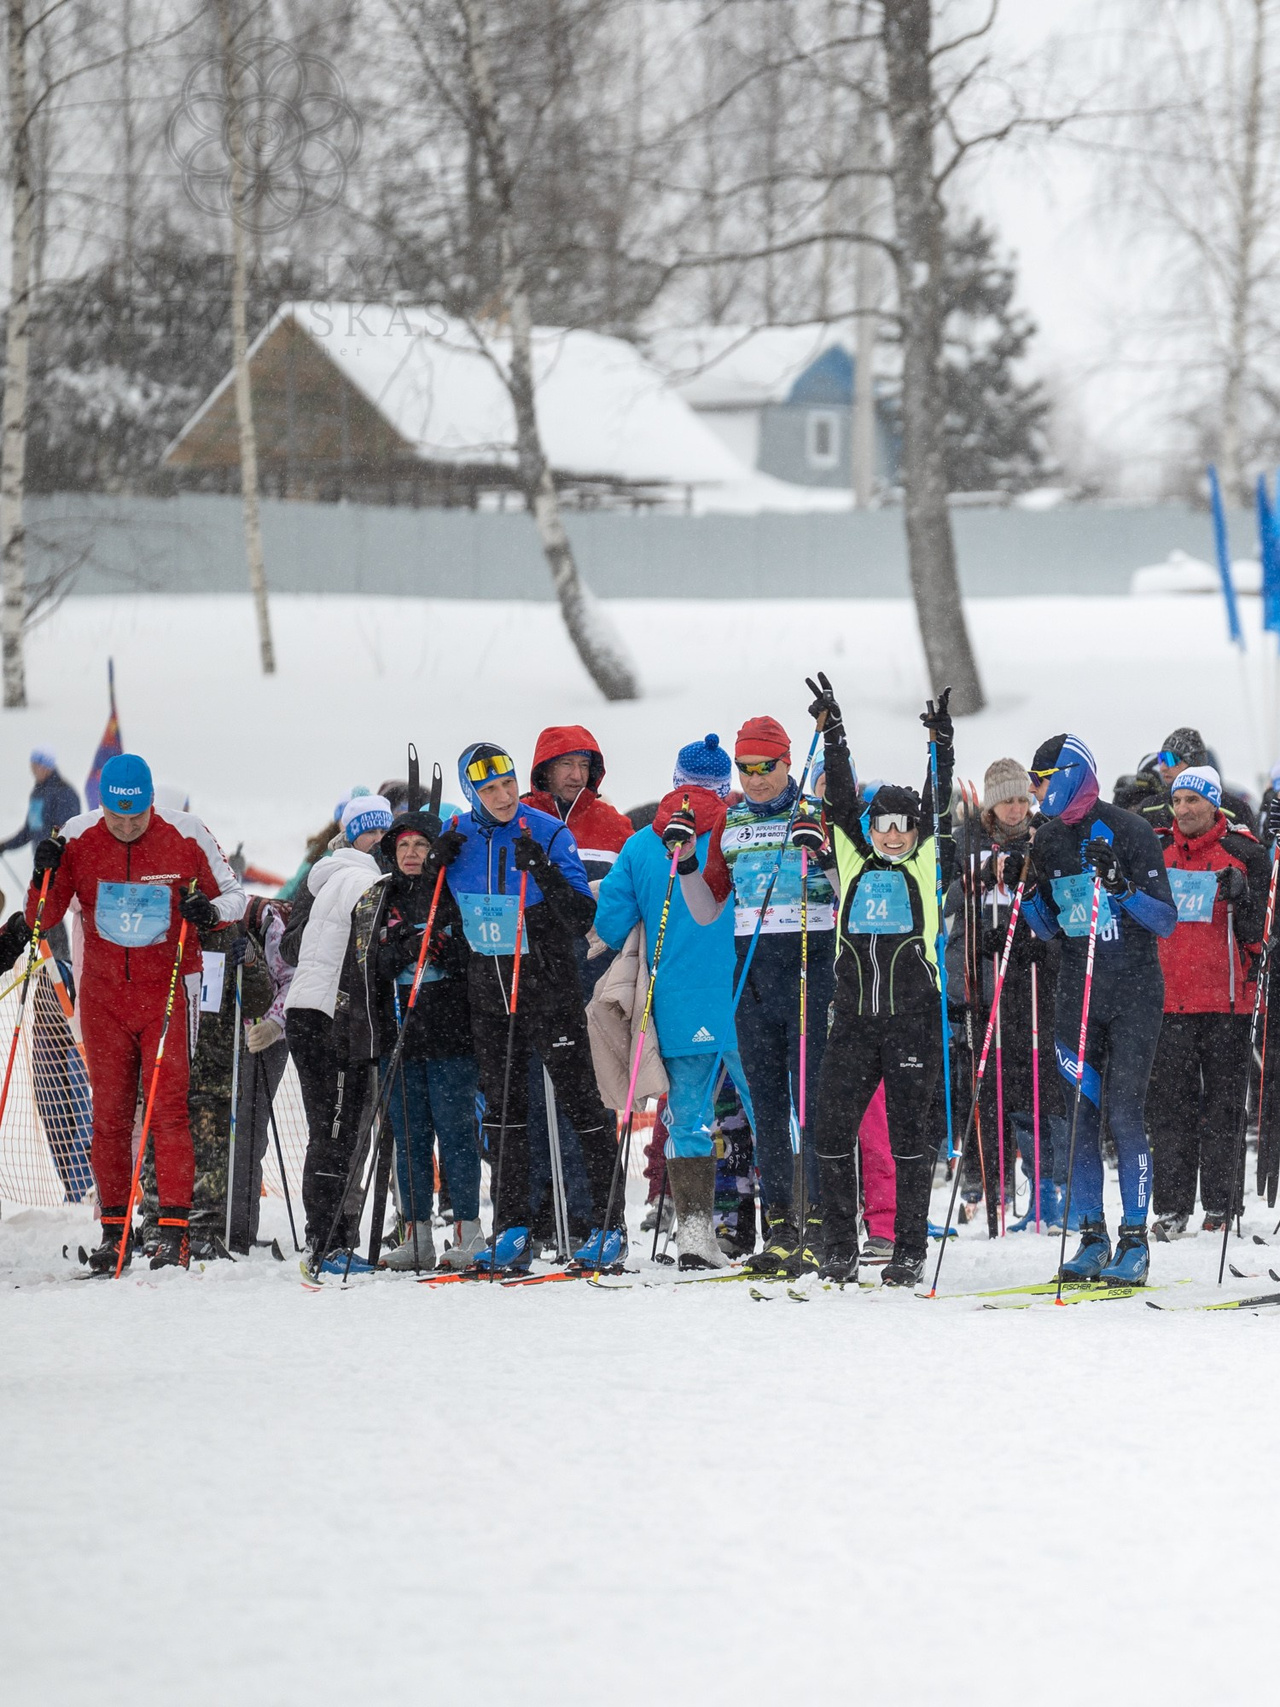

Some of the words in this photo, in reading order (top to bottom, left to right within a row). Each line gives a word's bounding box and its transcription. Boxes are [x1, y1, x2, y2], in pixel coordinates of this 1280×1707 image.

[109, 785, 142, 796] LUKOIL
[866, 899, 888, 920] 24
[1177, 893, 1204, 911] 741
[120, 912, 143, 933] 37
[659, 900, 670, 929] LEKI
[1069, 904, 1087, 922] 20
[479, 922, 501, 942] 18
[692, 1034, 715, 1042] adidas
[326, 1071, 348, 1139] SPINE
[1138, 1153, 1149, 1208] SPINE
